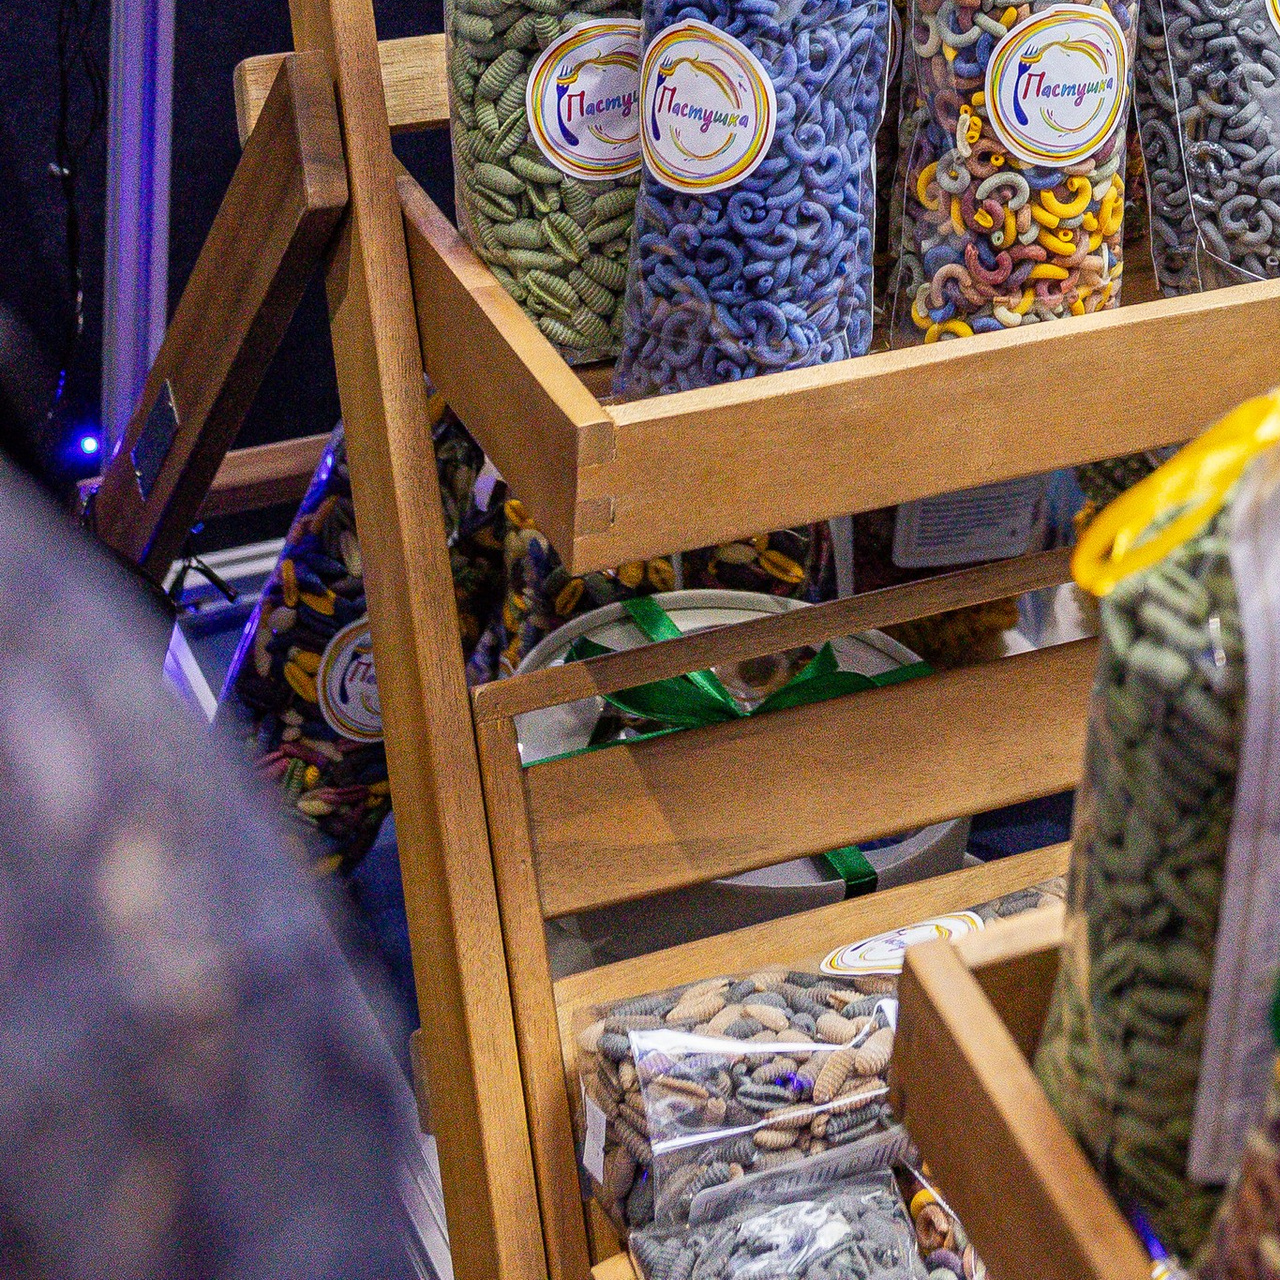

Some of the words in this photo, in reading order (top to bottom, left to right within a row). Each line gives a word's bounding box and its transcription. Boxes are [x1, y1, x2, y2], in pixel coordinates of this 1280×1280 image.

[566, 89, 638, 122] Пасту
[1022, 71, 1114, 107] Пастушка
[658, 85, 750, 133] Пастушка
